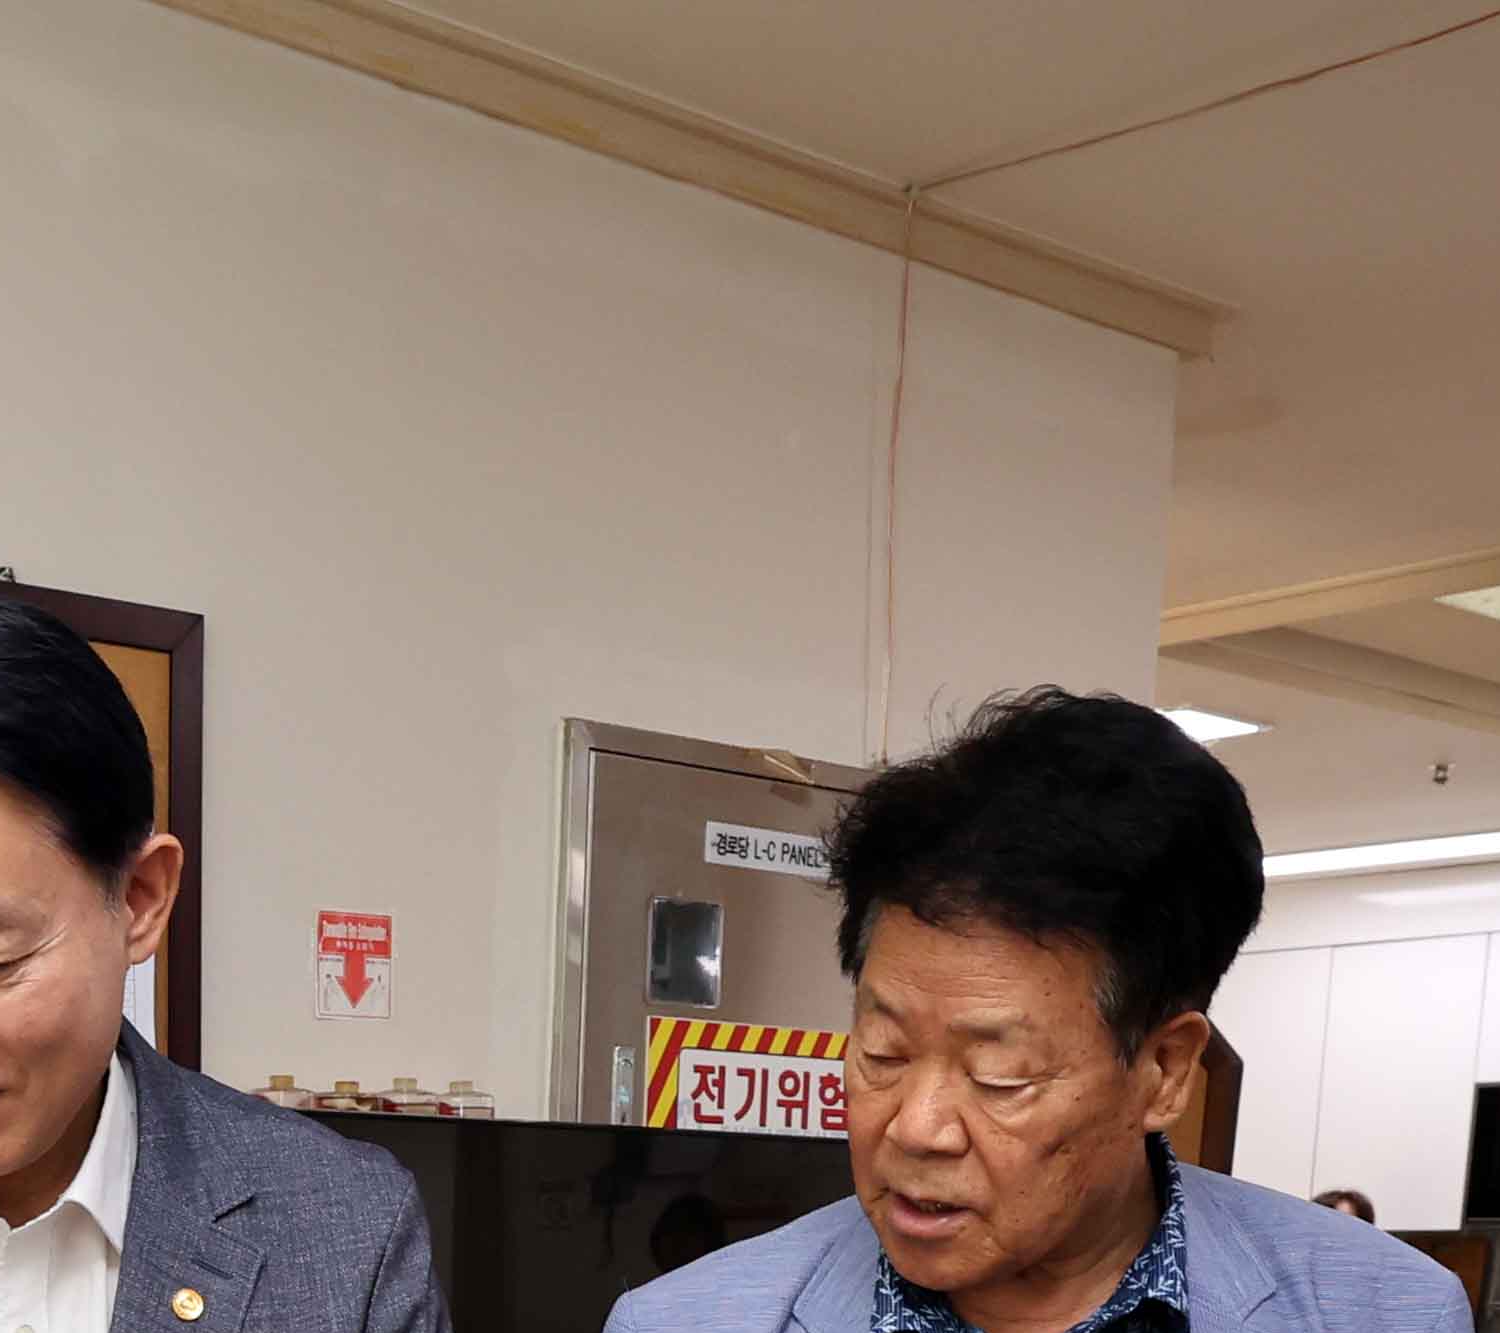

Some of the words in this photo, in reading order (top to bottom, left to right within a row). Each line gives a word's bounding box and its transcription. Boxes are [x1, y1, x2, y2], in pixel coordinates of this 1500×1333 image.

[716, 832, 749, 859] 경로당
[753, 839, 777, 862] L-C
[690, 1063, 849, 1131] 전기위험
